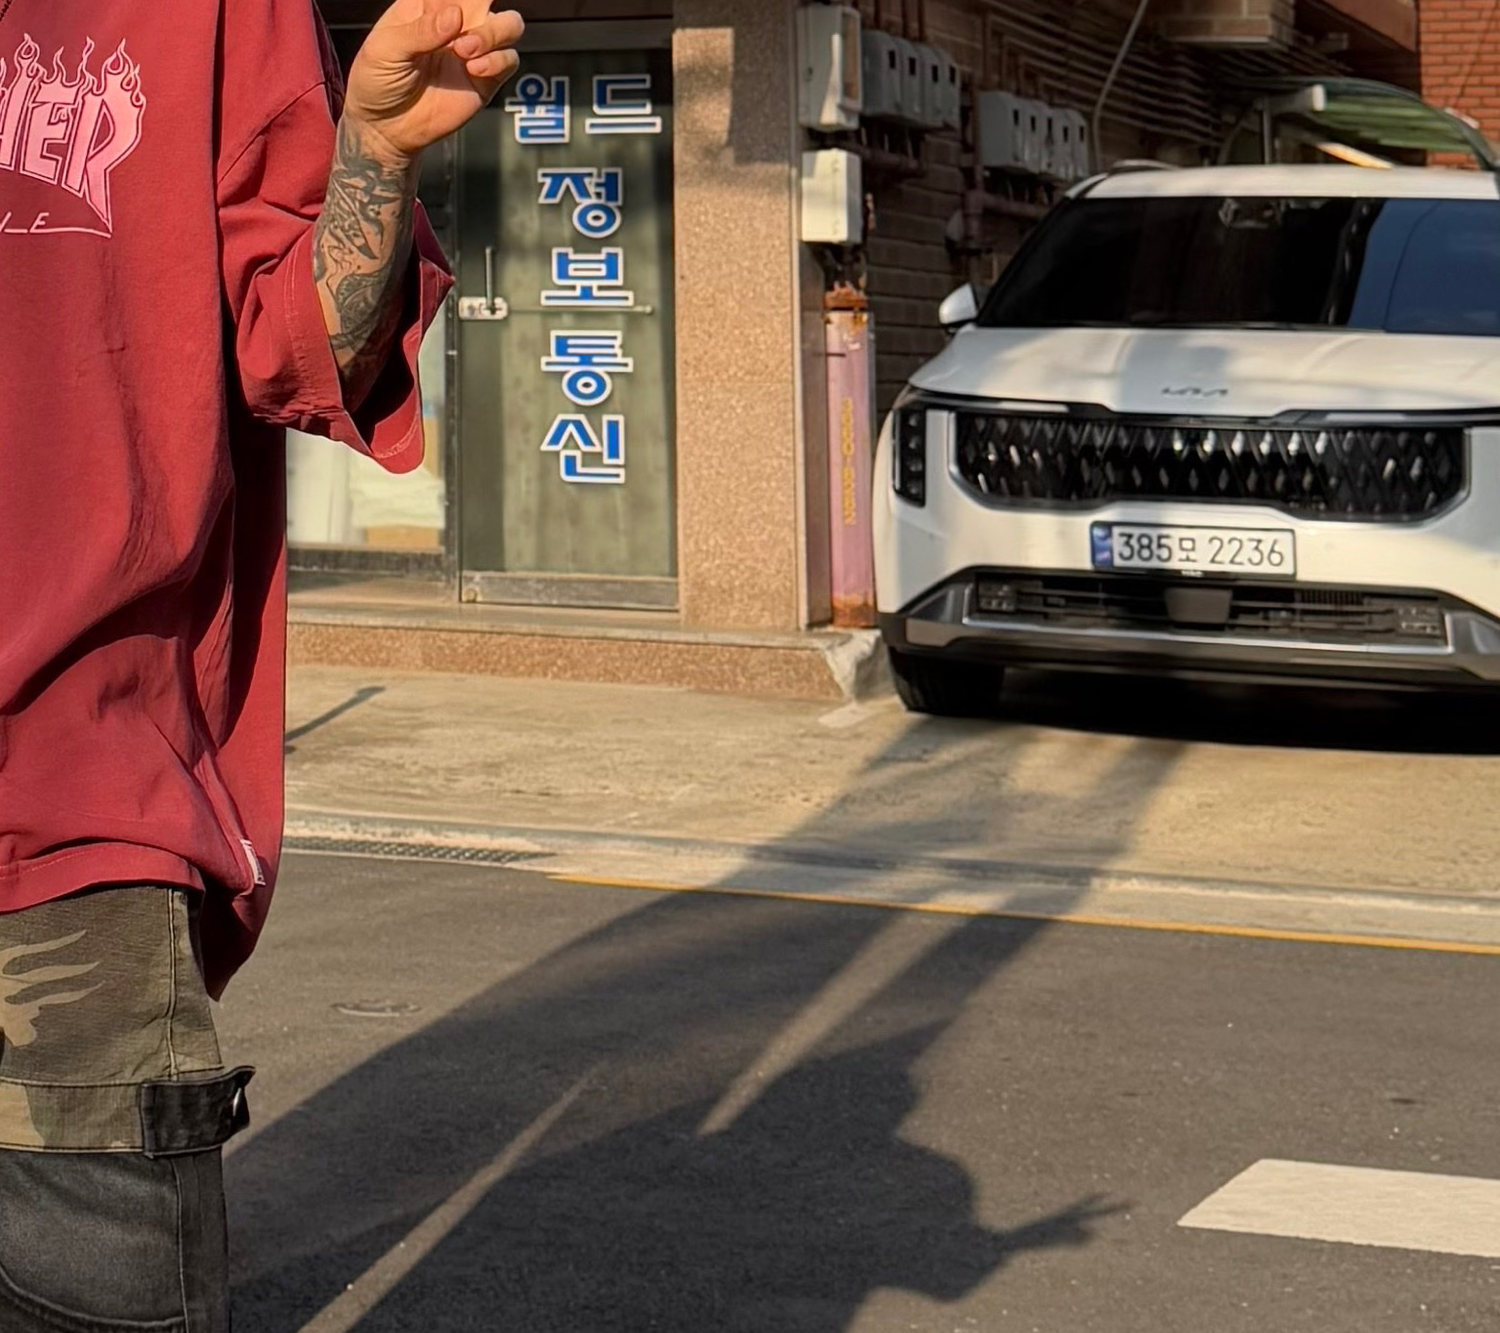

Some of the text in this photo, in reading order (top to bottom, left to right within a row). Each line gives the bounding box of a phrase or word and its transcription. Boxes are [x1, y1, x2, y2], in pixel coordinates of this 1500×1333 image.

[505, 72, 662, 143] 월드
[537, 167, 635, 484] 정보통신
[1117, 531, 1285, 568] 385모 2236
